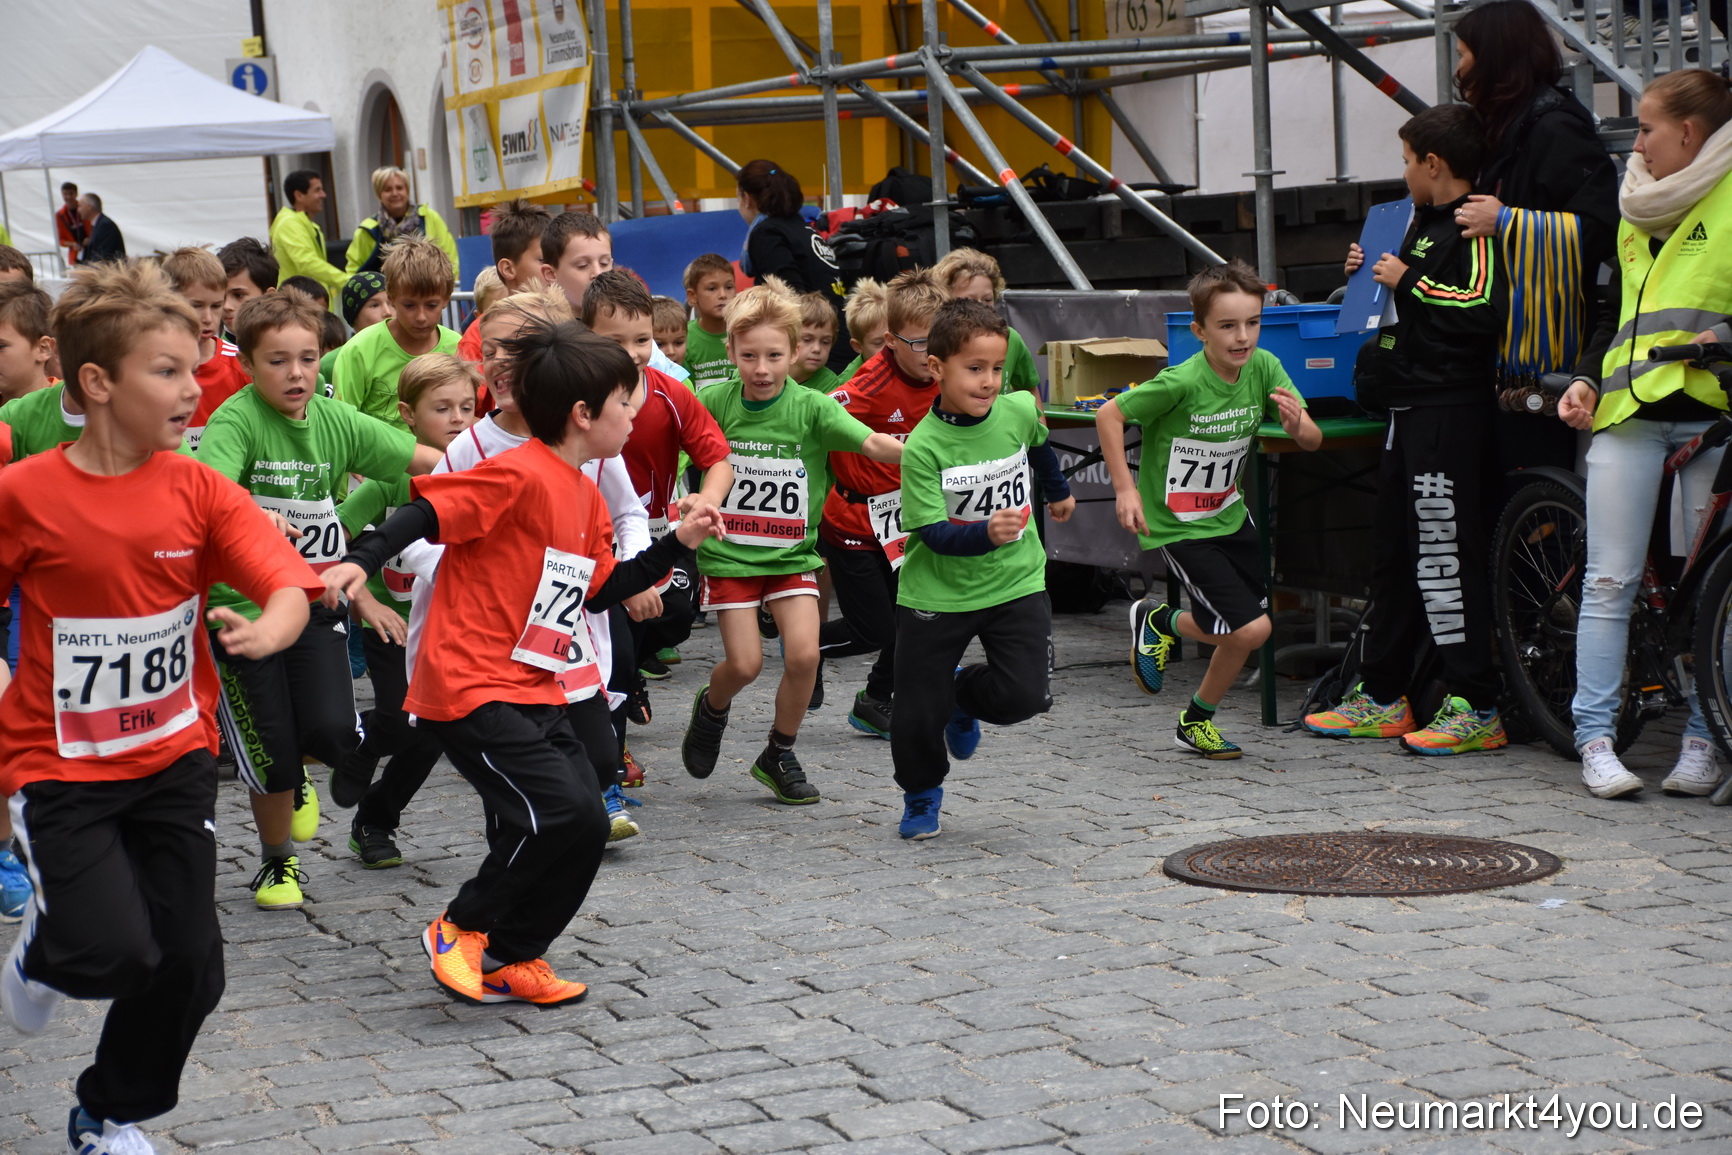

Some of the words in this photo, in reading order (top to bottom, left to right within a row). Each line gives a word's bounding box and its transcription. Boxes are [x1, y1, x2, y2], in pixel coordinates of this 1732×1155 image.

[502, 131, 525, 156] swn
[1190, 407, 1248, 423] Neumarkter
[1189, 420, 1238, 434] Stadtlauf
[728, 440, 774, 451] markter
[1173, 445, 1207, 457] PARTL
[1209, 444, 1248, 458] Neumarkt
[744, 466, 792, 477] Neumarkt
[945, 475, 982, 487] PARTL
[983, 461, 1021, 482] Neumarkt
[954, 471, 1025, 516] 7436
[1195, 496, 1225, 508] Luka
[871, 499, 898, 512] PARTL
[287, 509, 333, 520] Neumarkt
[763, 521, 808, 539] Joseph
[546, 560, 577, 578] PARTL
[57, 633, 113, 647] PARTL
[117, 620, 182, 646] Neumarkt
[72, 634, 187, 705] 7188
[119, 710, 156, 733] Erik
